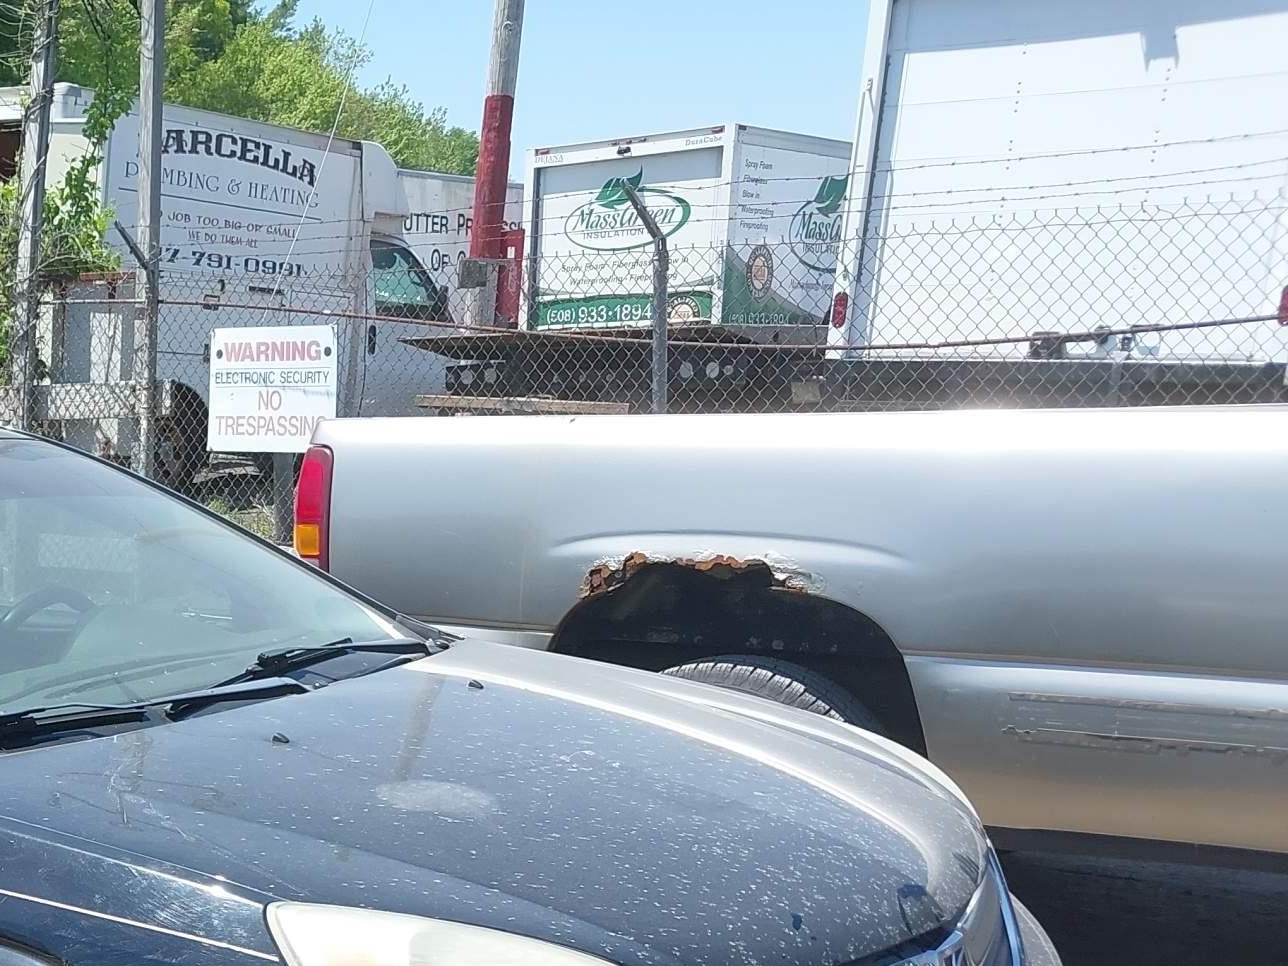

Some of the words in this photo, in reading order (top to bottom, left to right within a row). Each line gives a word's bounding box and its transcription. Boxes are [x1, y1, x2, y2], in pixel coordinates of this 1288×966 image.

[161, 129, 317, 187] ARCELLA
[124, 160, 220, 193] PMBING
[227, 178, 242, 195] &
[247, 181, 319, 209] HEATING
[168, 211, 191, 224] JOB
[196, 215, 220, 227] TOO
[224, 219, 243, 231] BIG
[246, 223, 263, 234] OR
[266, 224, 297, 240] SMALL
[403, 213, 450, 235] UTTER
[583, 228, 644, 241] INSULATION
[794, 210, 842, 241] MassG
[187, 230, 202, 241] WE
[204, 232, 217, 244] DO
[160, 246, 304, 277] 7-791-0991
[223, 339, 322, 363] WARNING
[214, 371, 276, 385] ELECTRONIC
[279, 370, 330, 384] SECURITY
[257, 390, 282, 411] NO
[215, 415, 326, 436] TRESPASSIN
